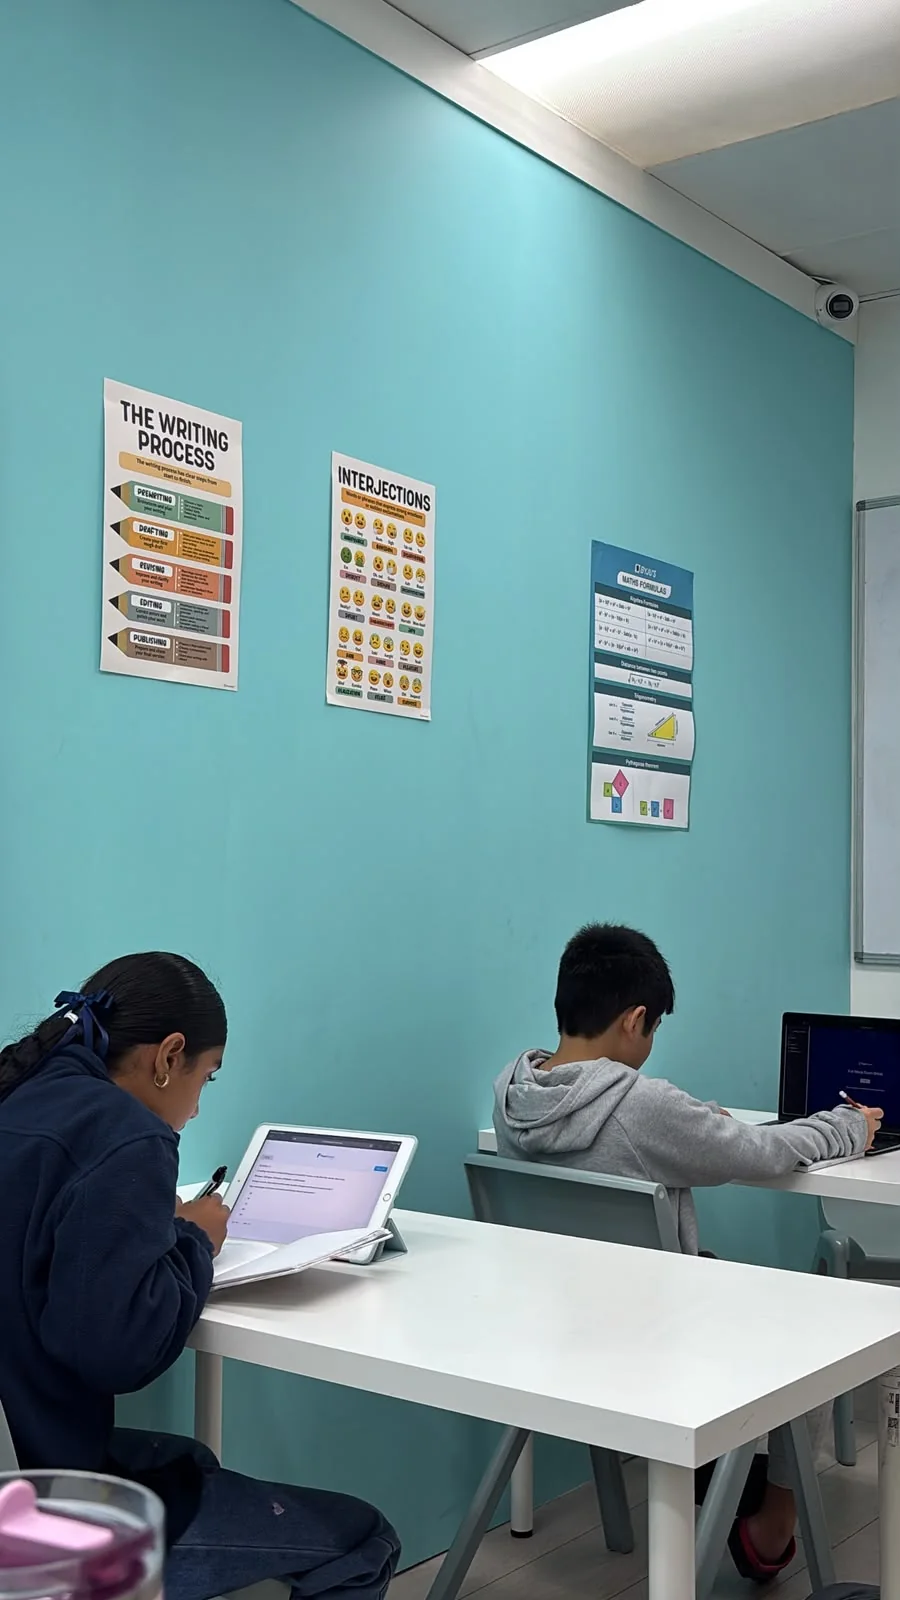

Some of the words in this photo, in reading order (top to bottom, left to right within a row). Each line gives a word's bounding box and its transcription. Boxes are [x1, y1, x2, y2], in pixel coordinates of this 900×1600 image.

[120, 400, 154, 429] THE
[159, 411, 228, 452] WRITING
[138, 430, 214, 471] PROCESS
[338, 466, 430, 511] INTERJECTIONS
[138, 489, 172, 503] PREWRITING
[139, 525, 168, 537] DRAFTING
[140, 562, 164, 573] REVISING
[622, 576, 638, 586] MATHS
[640, 581, 666, 595] FORMULAS
[140, 598, 162, 609] EDITING
[134, 634, 166, 646] PUBLISHING
